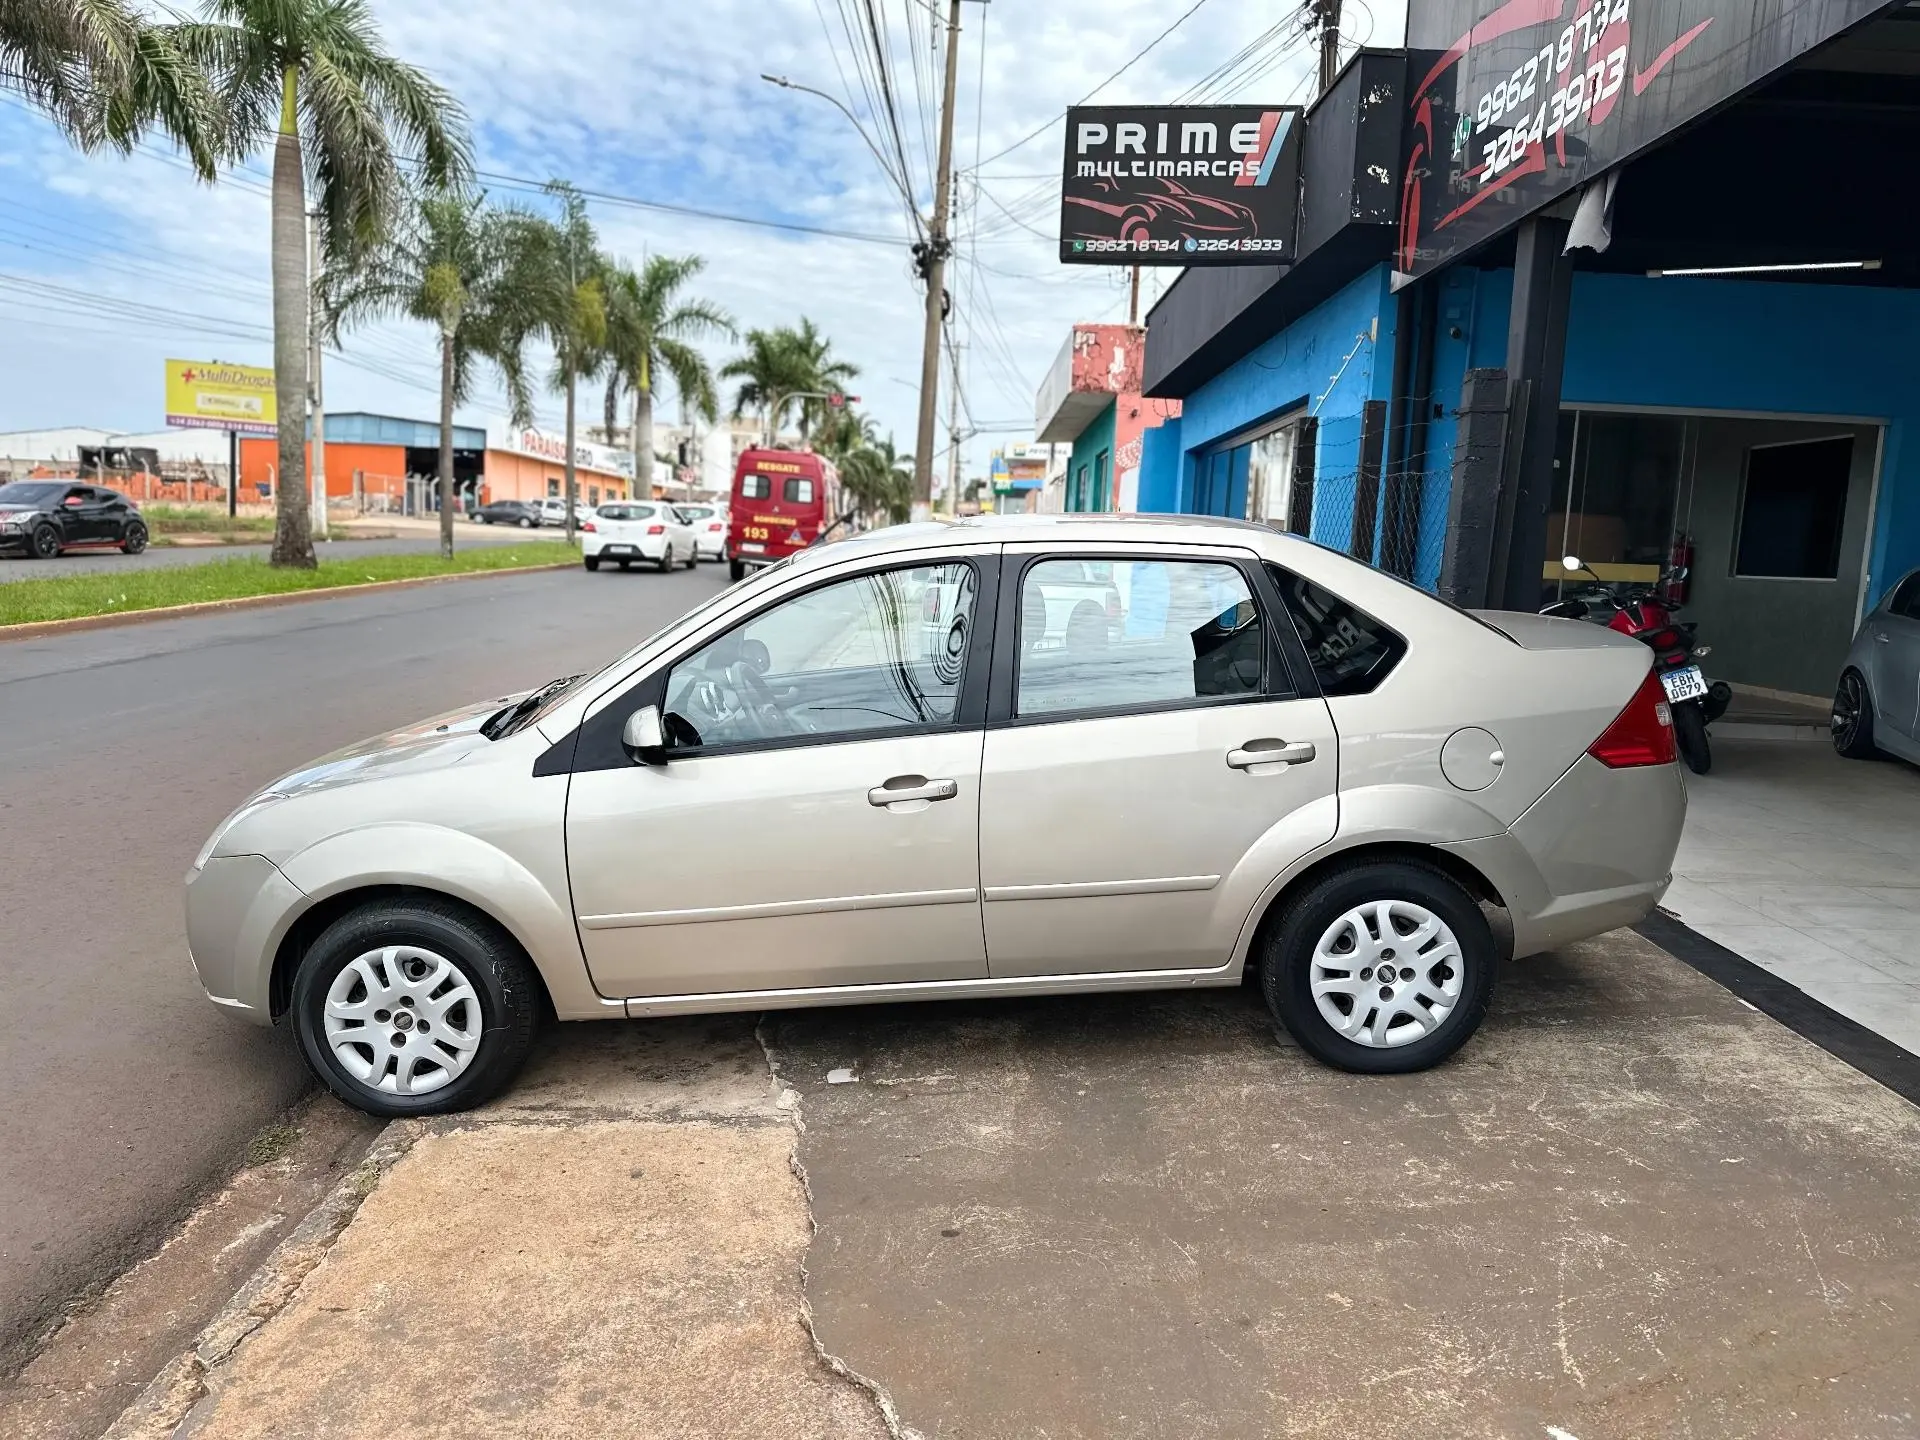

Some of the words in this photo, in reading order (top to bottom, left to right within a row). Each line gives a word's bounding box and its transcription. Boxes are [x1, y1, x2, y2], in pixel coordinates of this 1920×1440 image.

[1480, 45, 1627, 184] 32643933
[1077, 122, 1261, 154] PRIME
[1076, 160, 1261, 177] MULTIMARCAS
[1085, 239, 1180, 252] 996278734
[1197, 239, 1283, 251] 32643933
[757, 461, 800, 473] RESGATE
[743, 526, 769, 540] 193
[1671, 673, 1695, 688] EBH
